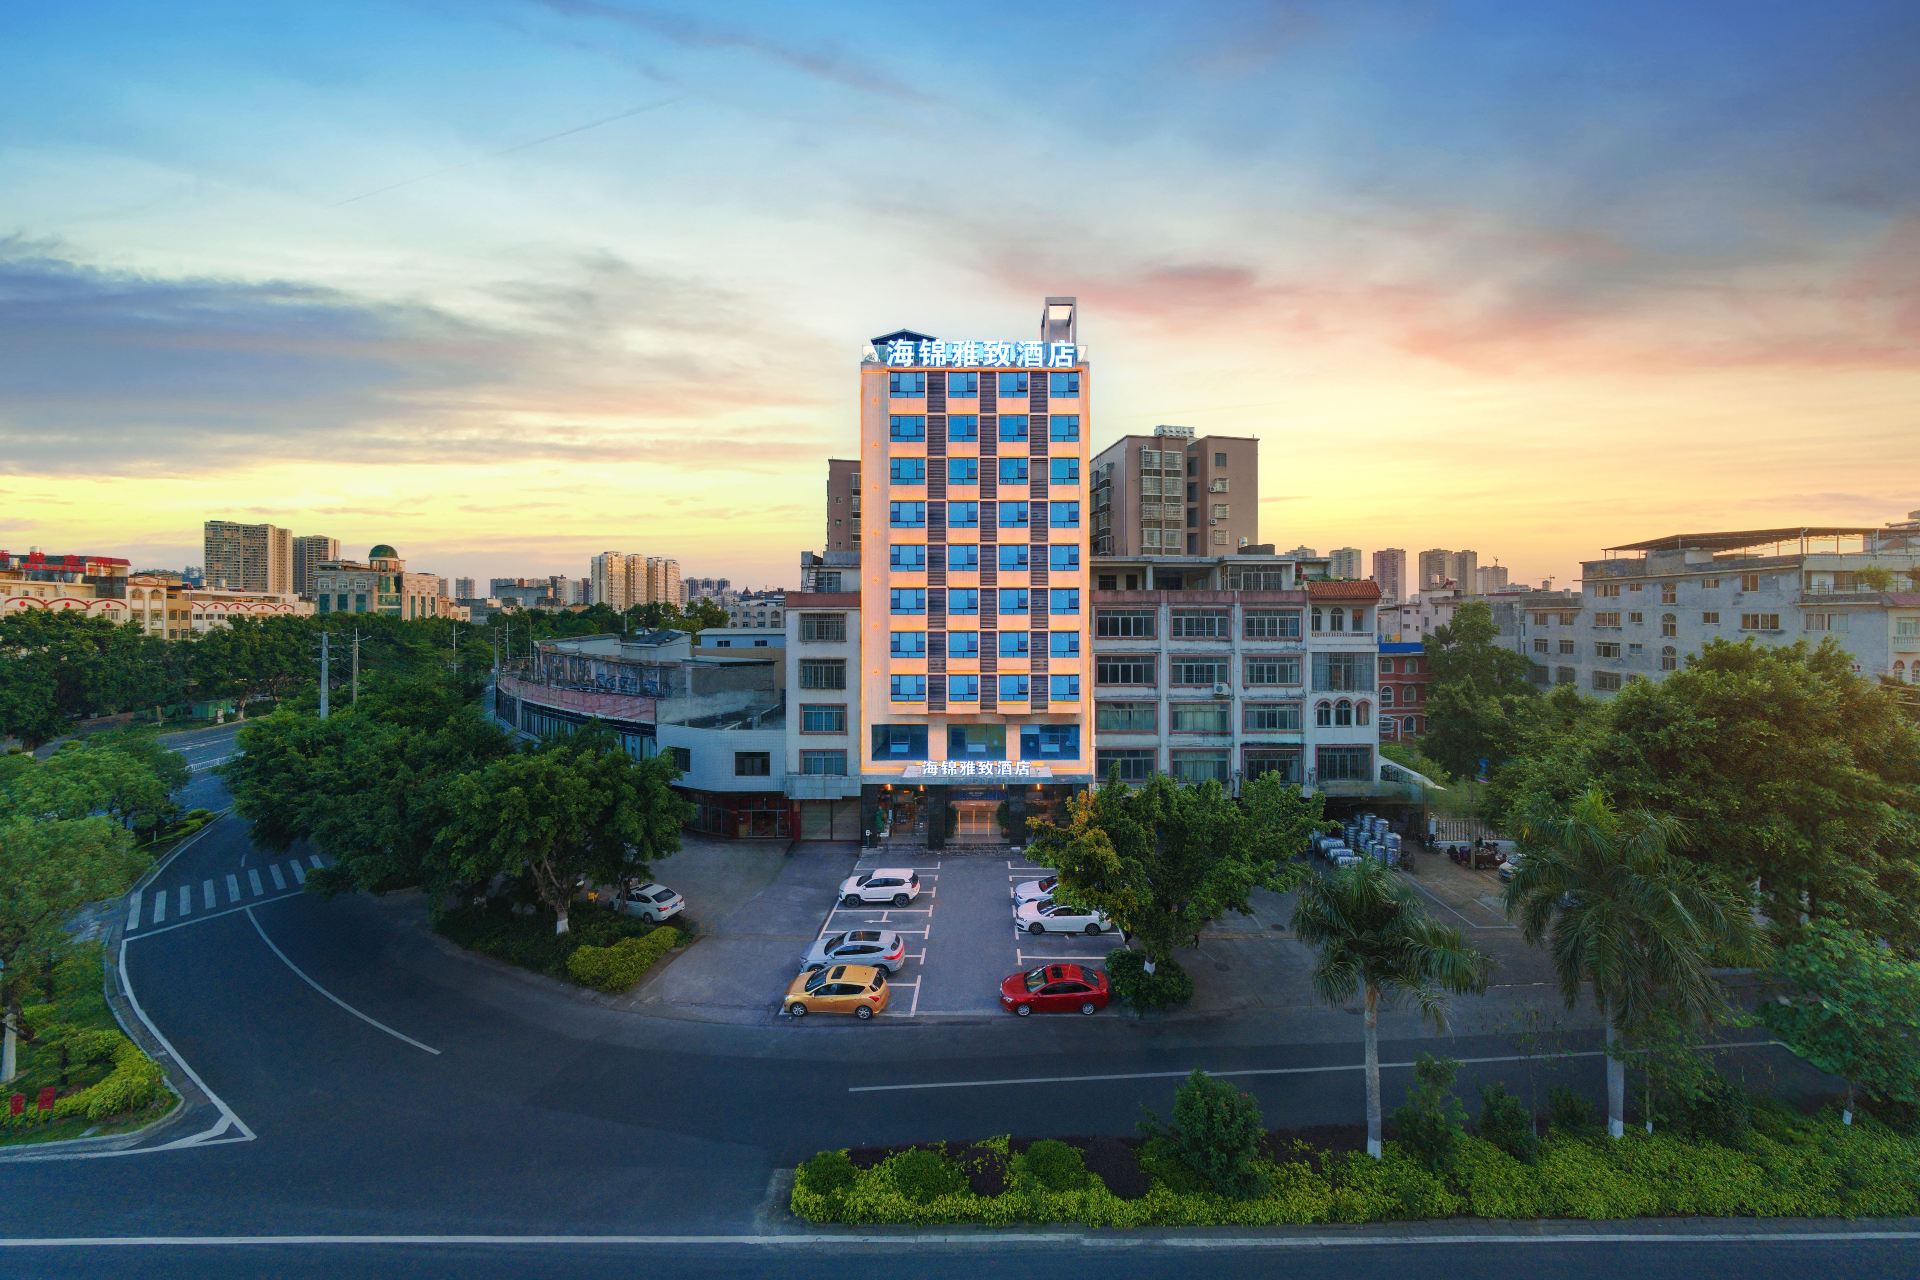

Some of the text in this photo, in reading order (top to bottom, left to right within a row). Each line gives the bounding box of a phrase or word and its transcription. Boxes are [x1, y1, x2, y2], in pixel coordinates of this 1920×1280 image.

[886, 338, 1075, 368] 海锦雅致酒店
[921, 760, 1031, 776] 海锦雅致酒店
